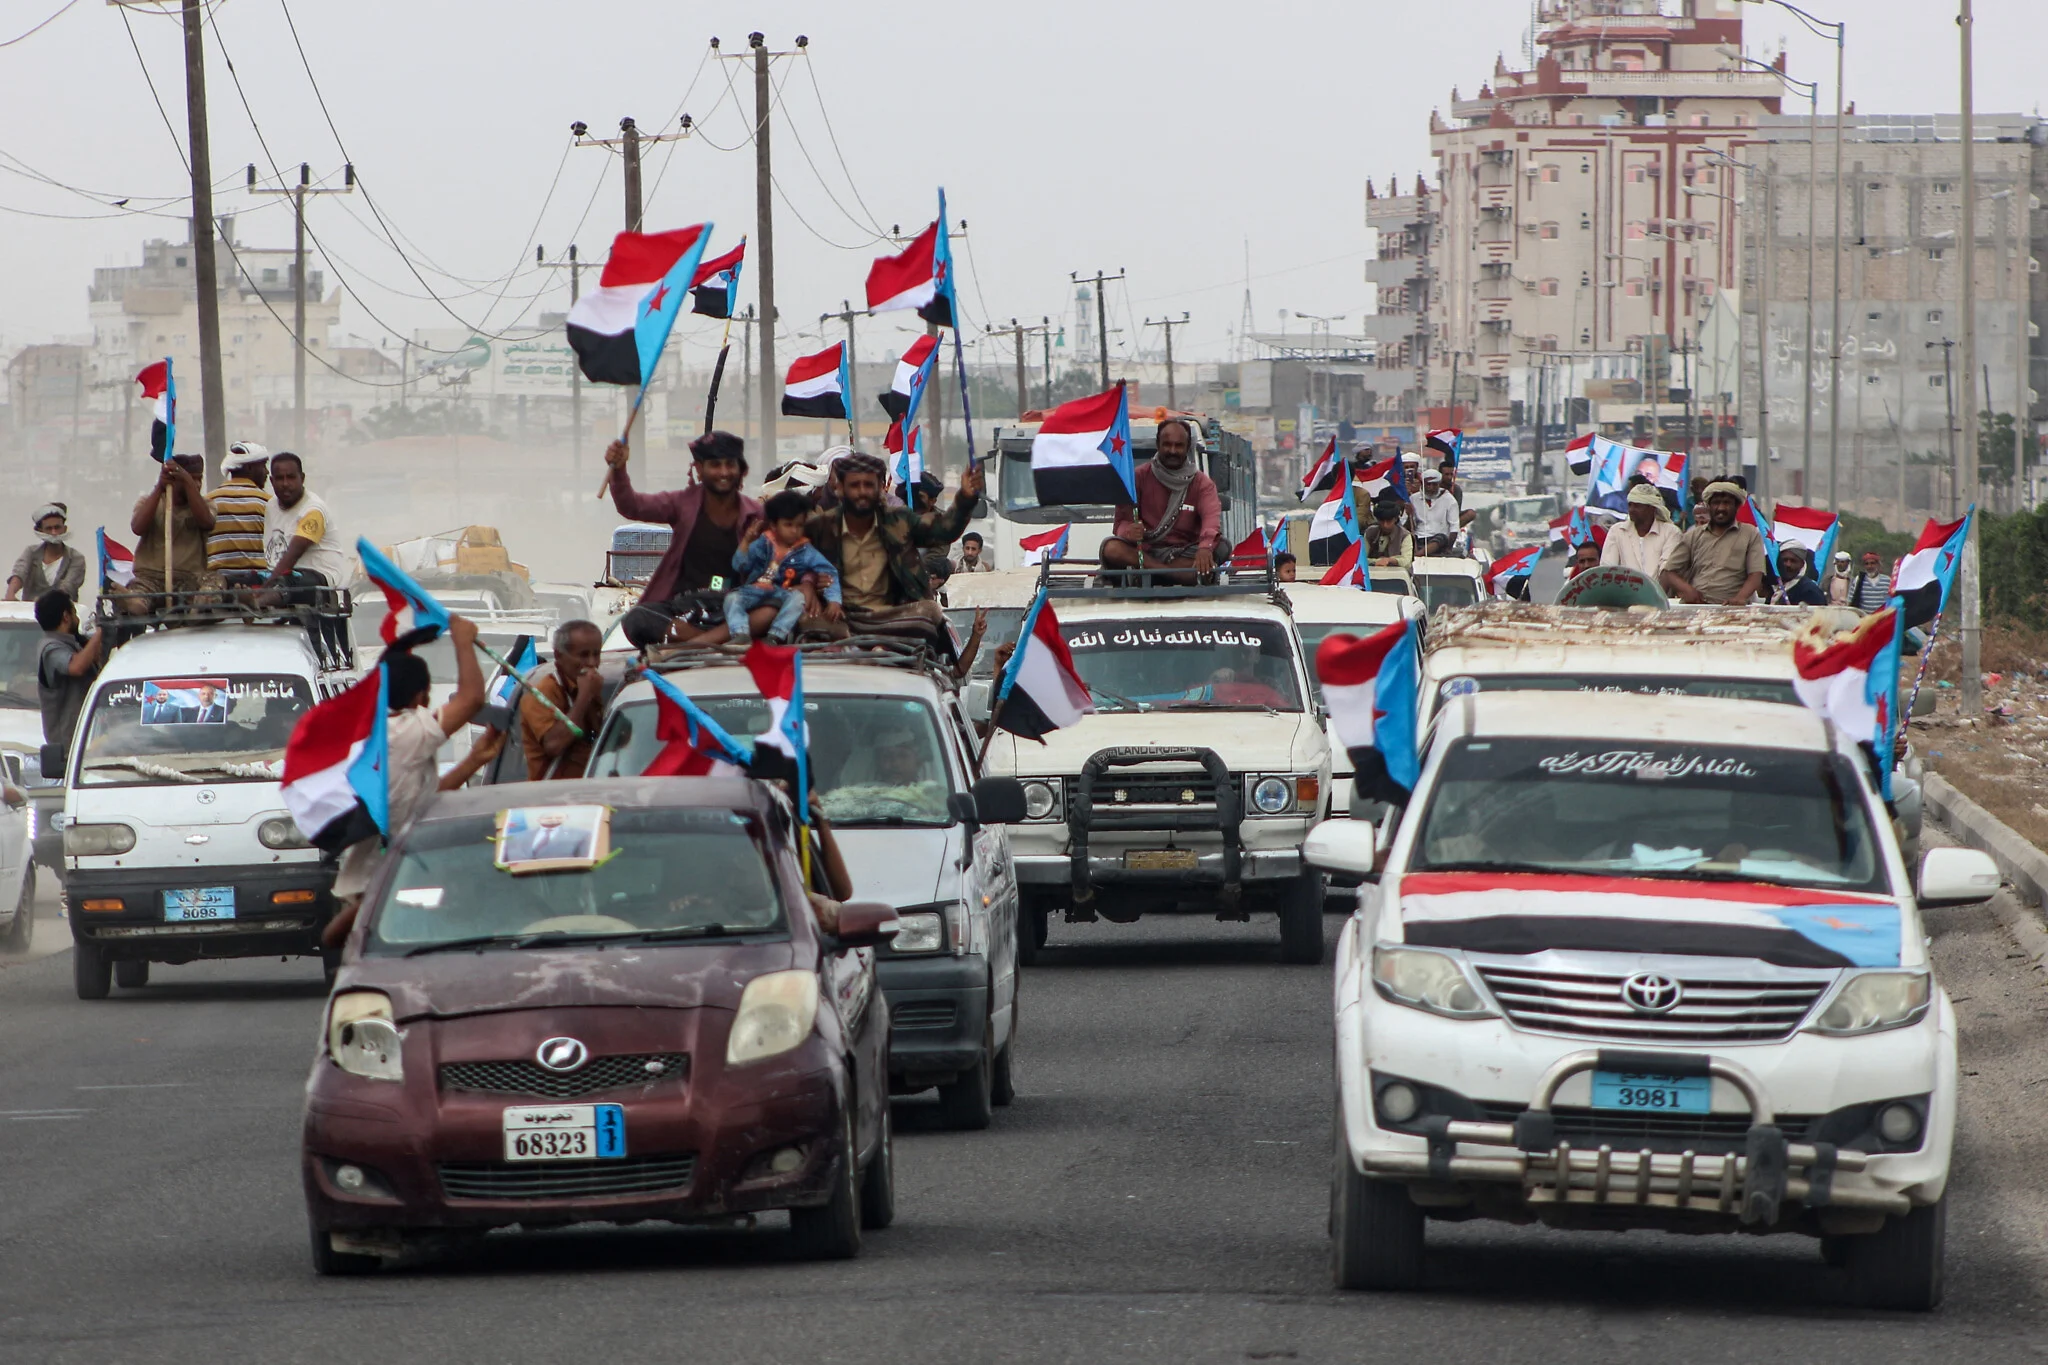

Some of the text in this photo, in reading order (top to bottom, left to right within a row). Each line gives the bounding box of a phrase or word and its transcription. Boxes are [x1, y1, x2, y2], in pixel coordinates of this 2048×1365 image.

[1068, 632, 1105, 648] الله
[1113, 629, 1161, 646] تبارك
[1164, 630, 1202, 645] الله
[182, 907, 217, 919] 8098
[1619, 1087, 1680, 1108] 3981
[524, 1113, 573, 1124] حضرموت
[515, 1131, 587, 1156] 68323
